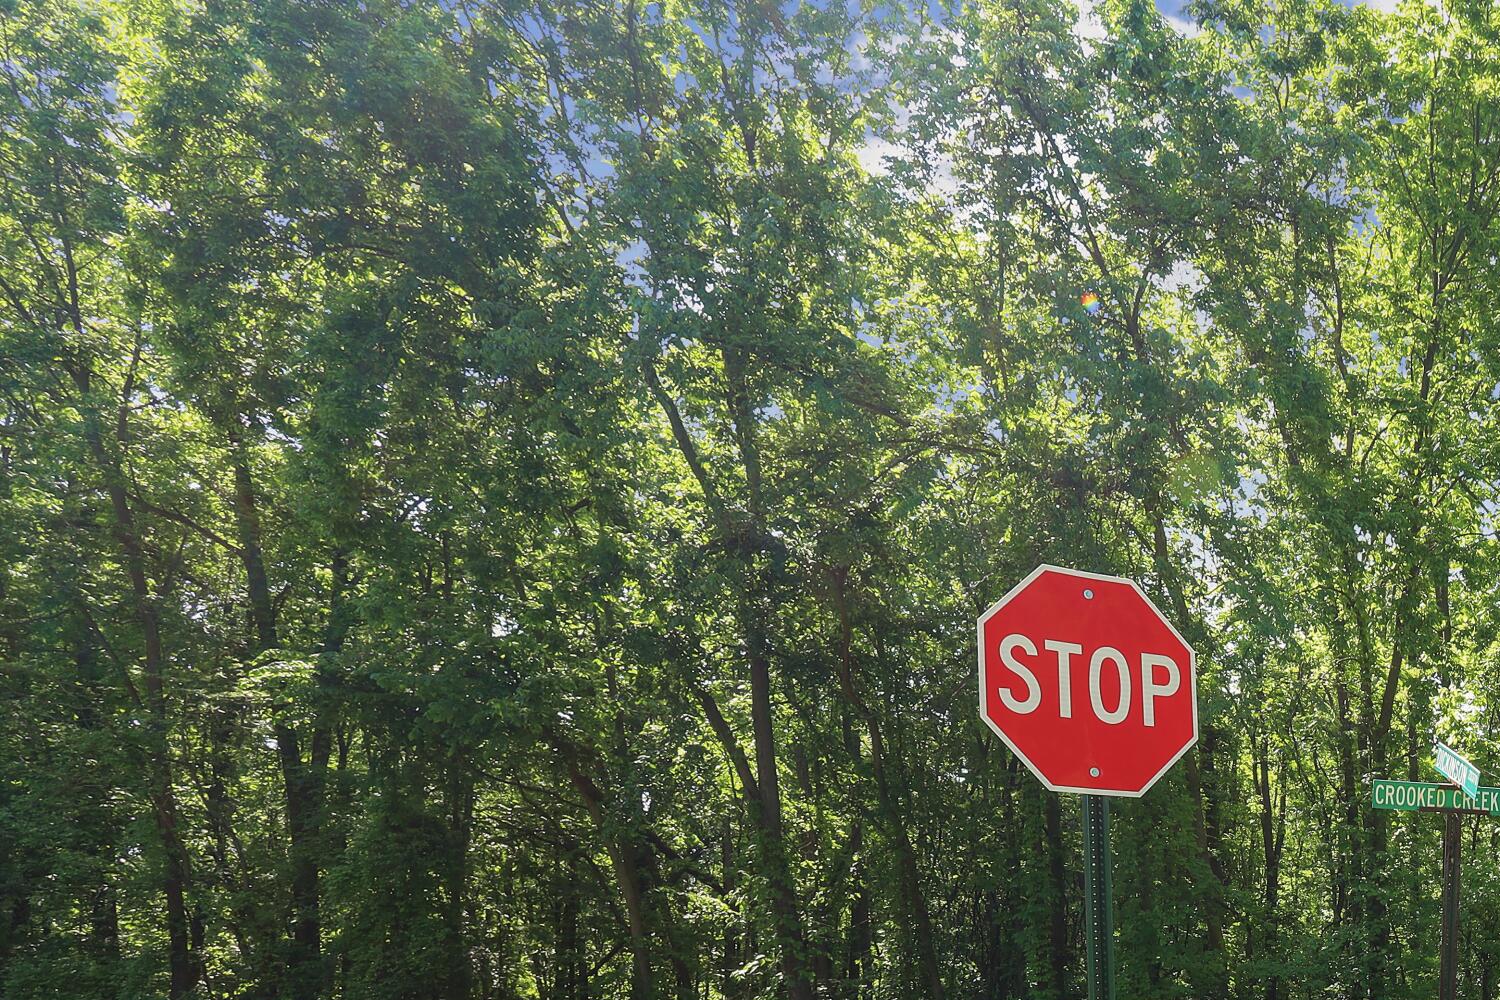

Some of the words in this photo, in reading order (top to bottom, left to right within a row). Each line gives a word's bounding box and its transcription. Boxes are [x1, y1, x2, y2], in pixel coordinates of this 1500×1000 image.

[998, 633, 1181, 727] STOP
[1375, 784, 1446, 808] CROOKED
[1453, 789, 1499, 812] CREEK
